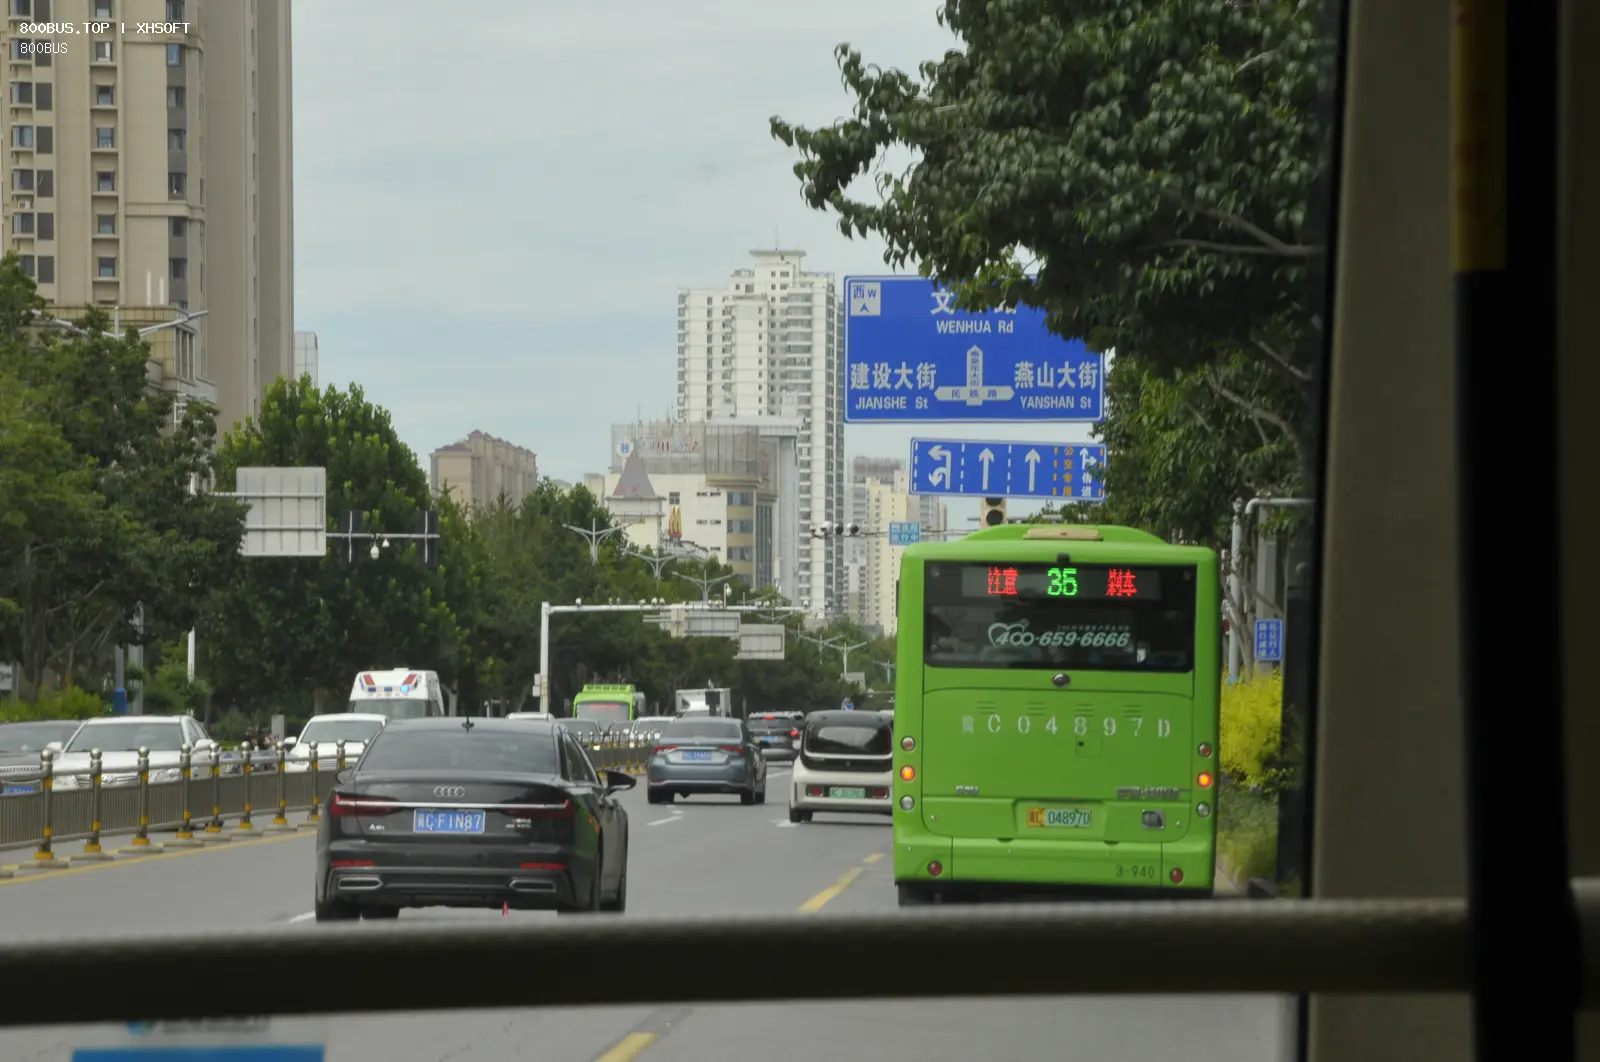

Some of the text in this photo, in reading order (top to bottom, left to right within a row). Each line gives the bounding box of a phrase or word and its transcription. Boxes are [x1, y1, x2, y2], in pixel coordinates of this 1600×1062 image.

[936, 320, 1014, 334] WENHUA Rd
[850, 361, 937, 390] 建设大街
[1014, 361, 1098, 389] 燕山大街
[855, 397, 929, 410] JIANSHE St
[1020, 396, 1092, 409] YANSHAN St
[987, 566, 1019, 595] 注意
[1047, 568, 1078, 596] 35
[995, 631, 1131, 648] 400-659-6666
[1115, 864, 1155, 879] 3-940
